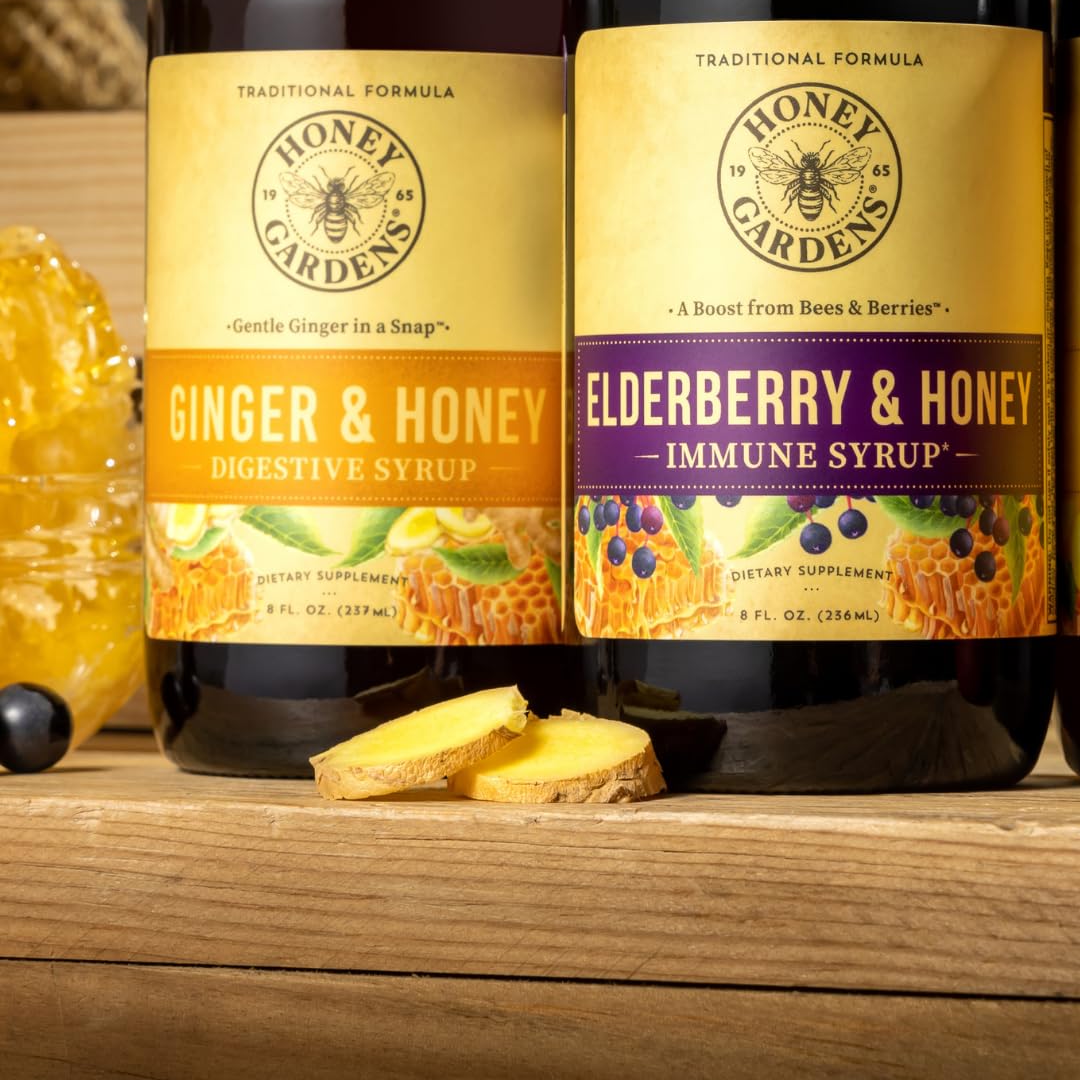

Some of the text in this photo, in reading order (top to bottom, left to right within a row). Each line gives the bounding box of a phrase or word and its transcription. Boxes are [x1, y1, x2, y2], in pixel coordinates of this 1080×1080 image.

[696, 52, 924, 68] TRADITIONAL FORMULA
[237, 85, 455, 98] TRADITIONAL FORMULA
[743, 91, 881, 144] HONEY
[275, 118, 404, 168] HONEY
[729, 164, 890, 178] 19 65
[263, 189, 413, 201] 19 65
[677, 300, 689, 316] A
[693, 300, 743, 316] Boost
[747, 299, 794, 316] from
[799, 300, 844, 316] Bees
[848, 300, 862, 315] &
[233, 318, 284, 334] Gentle
[289, 318, 348, 338] Ginger
[354, 319, 372, 334] in
[376, 323, 386, 334] a
[587, 369, 1033, 427] ELDERBERRY & HONEY
[170, 384, 547, 445] GINGER & HONEY
[666, 442, 817, 469] IMMUNE
[211, 456, 477, 482] DIGESTIVE SYRUP
[257, 570, 410, 586] DIETARY SUPPLEMENT
[731, 565, 894, 582] DIETARY SUPPLEMENT
[266, 605, 398, 619] 8 FL. OZ. (237ML)
[740, 610, 880, 624] 8 FL. OZ. (236ML)
